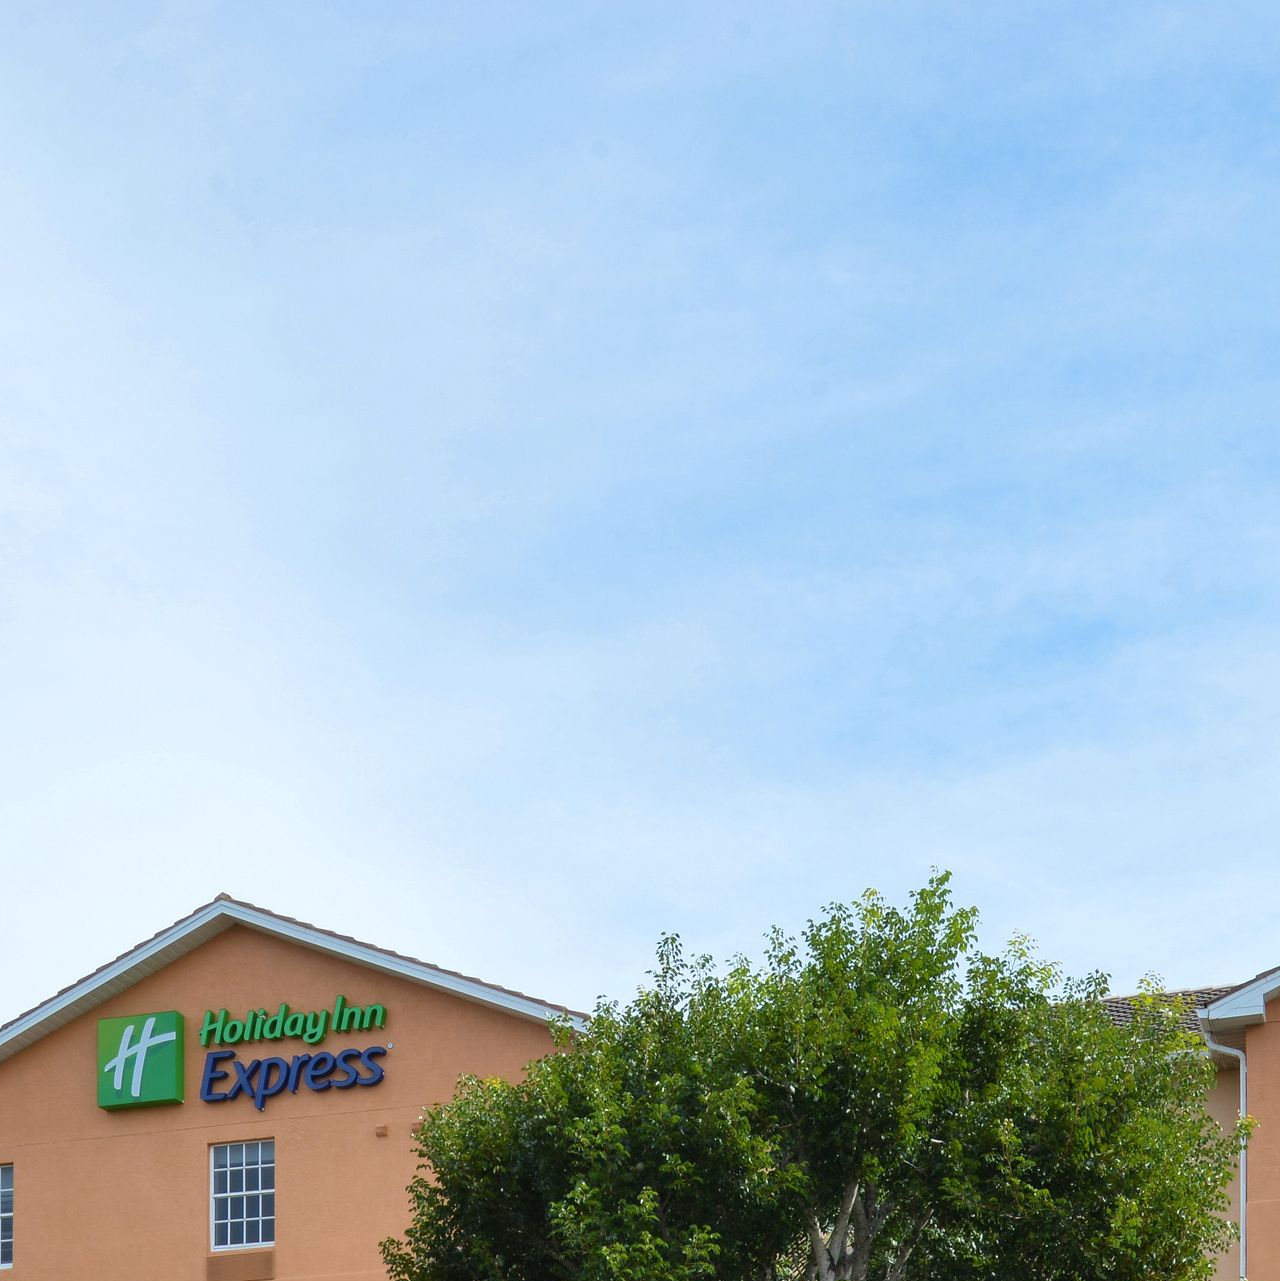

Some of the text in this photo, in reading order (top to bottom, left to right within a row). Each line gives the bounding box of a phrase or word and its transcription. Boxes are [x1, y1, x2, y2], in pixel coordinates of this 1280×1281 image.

[199, 994, 386, 1047] Holiday Inn
[199, 1046, 388, 1113] Express
